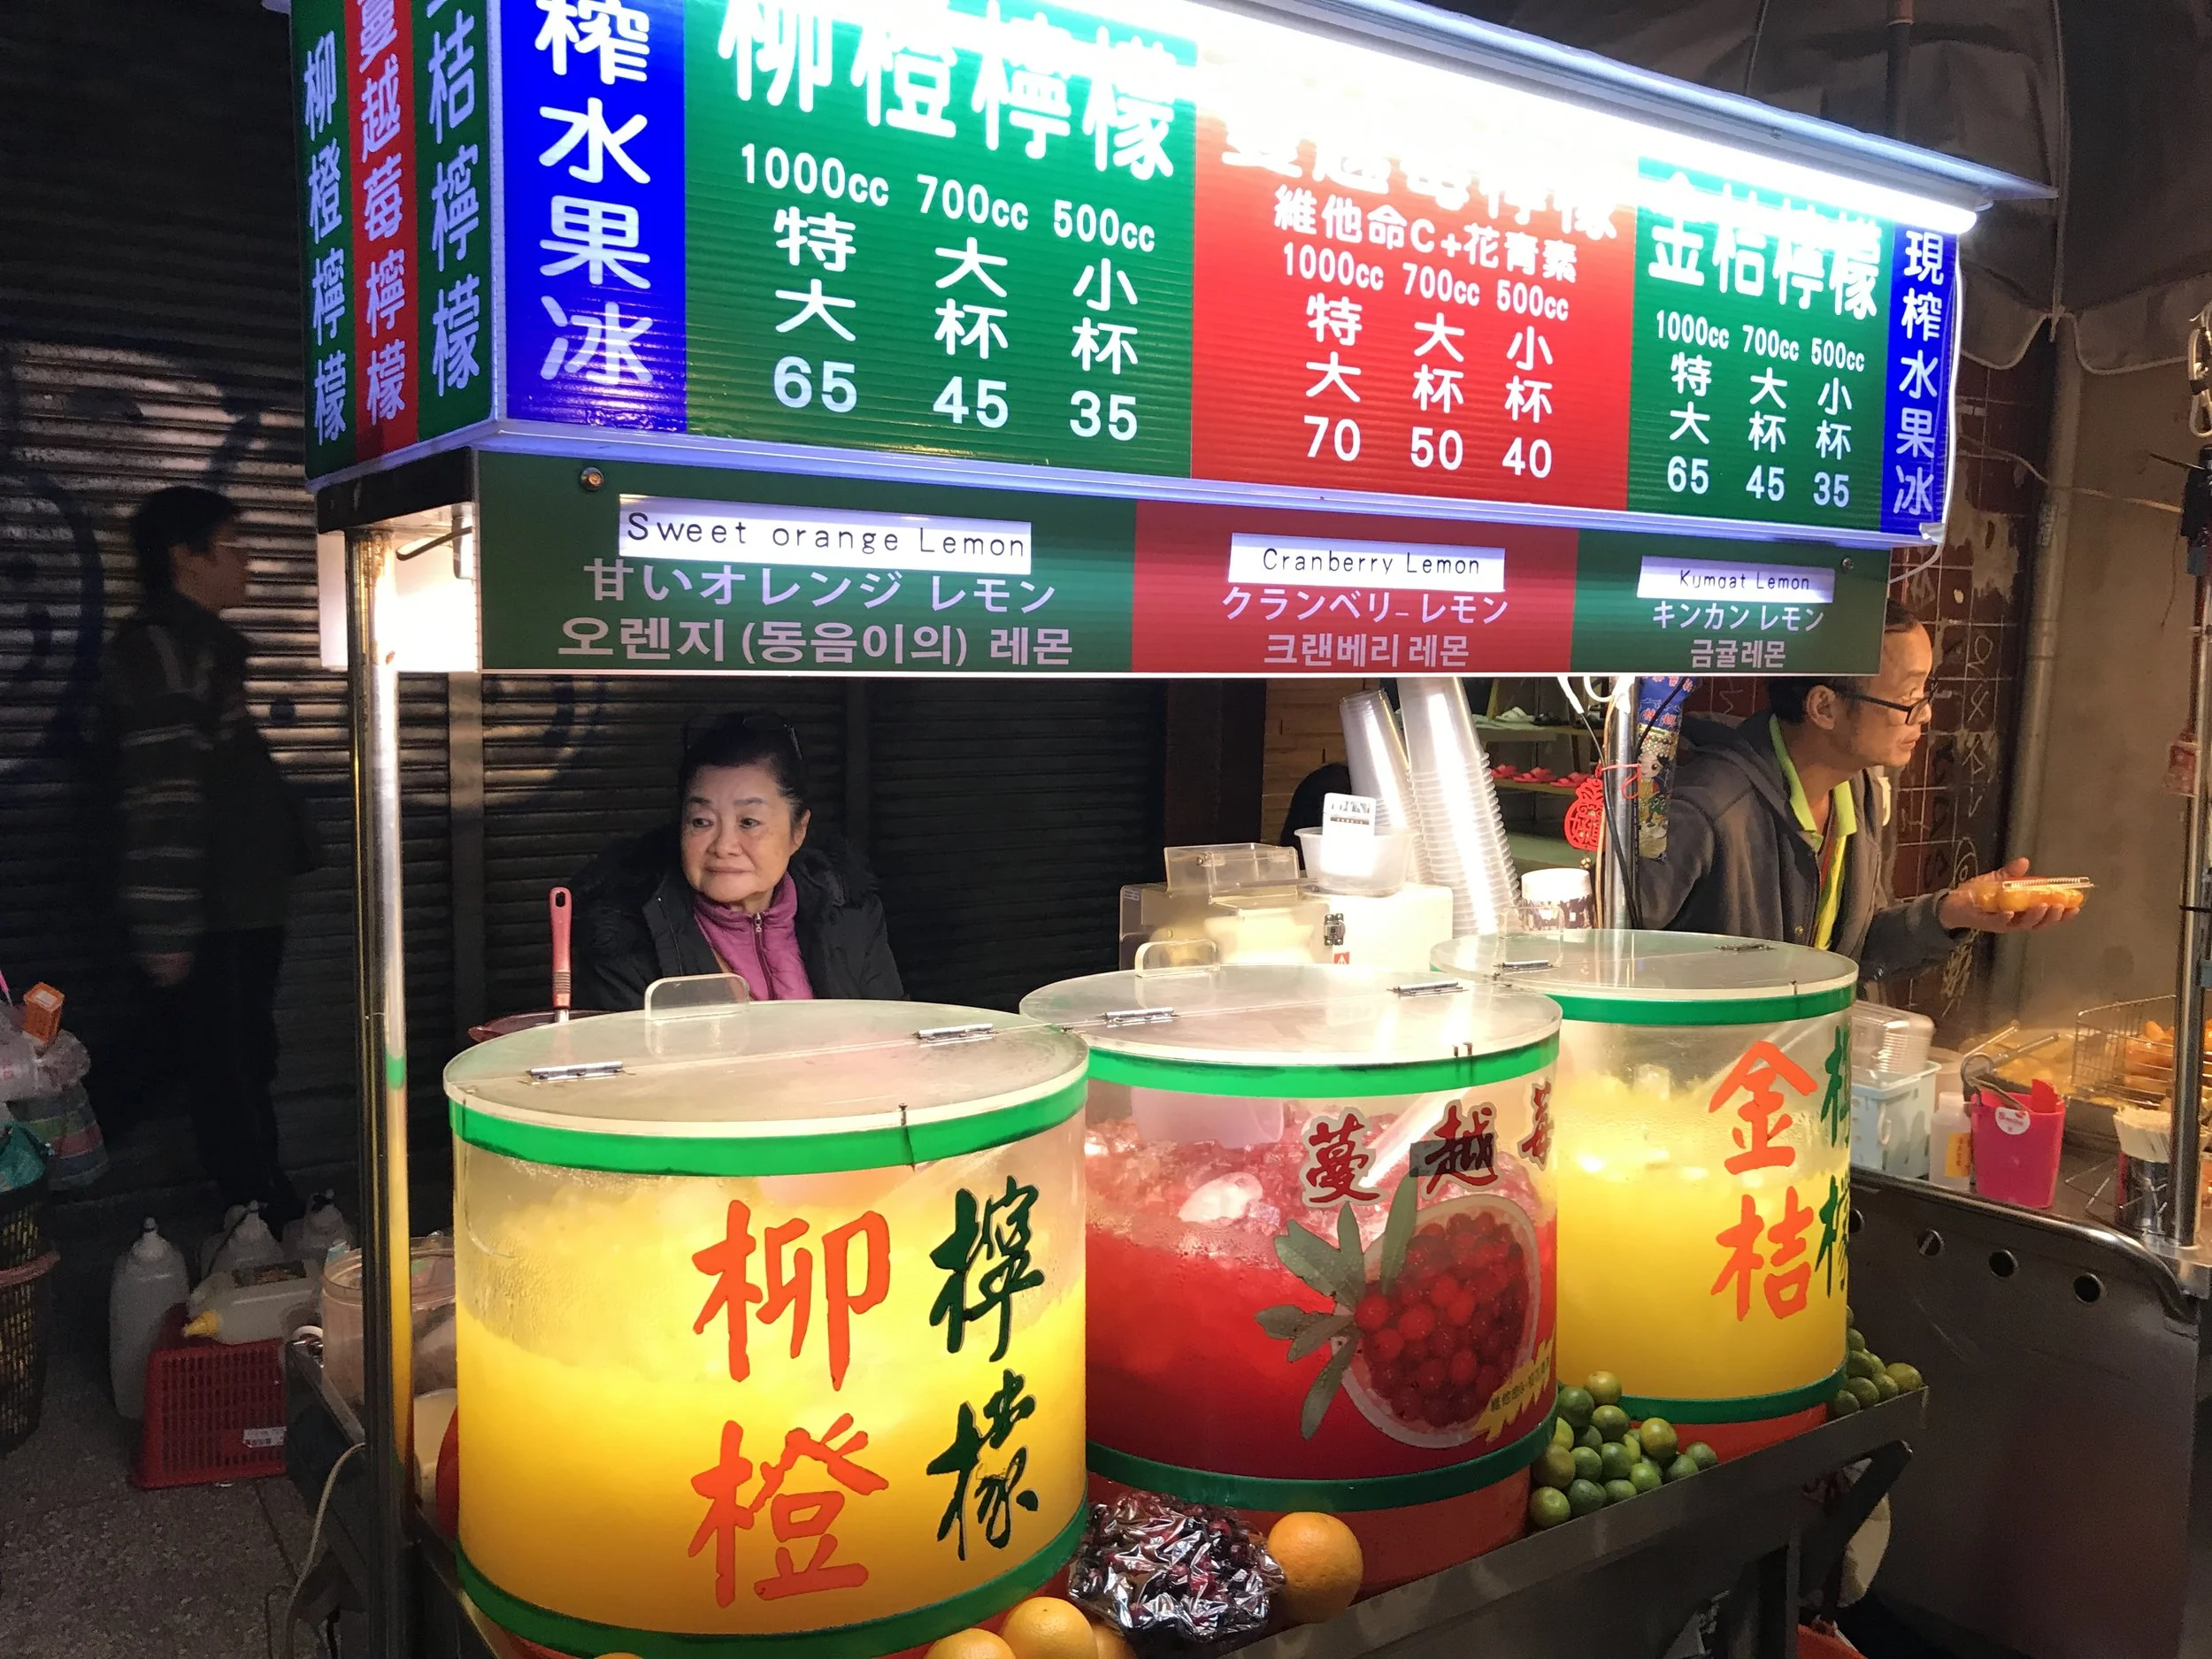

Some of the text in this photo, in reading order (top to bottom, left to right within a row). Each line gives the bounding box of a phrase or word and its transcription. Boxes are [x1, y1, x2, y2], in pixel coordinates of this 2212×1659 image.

[303, 30, 346, 446] 柳橙檸檬
[426, 0, 480, 396] 桔檸檬
[534, 0, 653, 385] 榨水果冰
[741, 143, 1154, 251] 1000cc 700cc 500cc
[773, 206, 856, 342] 特大
[1284, 242, 1569, 321] 1000cc 700cc 500cc
[1648, 172, 1882, 320] 金桔檸檬
[934, 237, 1008, 359] 大杯
[1071, 258, 1138, 374] 小杯
[1656, 311, 1865, 373] 1000cc 700cc 500cc
[1306, 293, 1363, 403] 特大
[1413, 312, 1464, 413] 大杯
[1505, 326, 1553, 423] 小杯
[1893, 230, 1944, 516] 現榨水果冰
[773, 356, 1138, 441] 65 45 35
[1670, 351, 1712, 444] 特大
[1748, 367, 1787, 453] 大杯
[1816, 378, 1852, 460] 小杯
[1304, 415, 1552, 479] 70 50 40
[1667, 456, 1849, 507] 65 45 35
[626, 512, 1025, 557] Sweet orange Lemon
[1263, 548, 1480, 575] Cranberry Lemon
[1756, 572, 1809, 590] Lemon
[584, 558, 1056, 614] 甘いオレンジ レモン
[558, 617, 1073, 666] 오렌지 (동음이의) 레몬
[1263, 633, 1469, 667] 크랜베리 레몬
[1709, 1041, 1818, 1321] 金桔
[688, 1199, 891, 1609] 柳橙
[926, 1176, 1044, 1561] 檸檬
